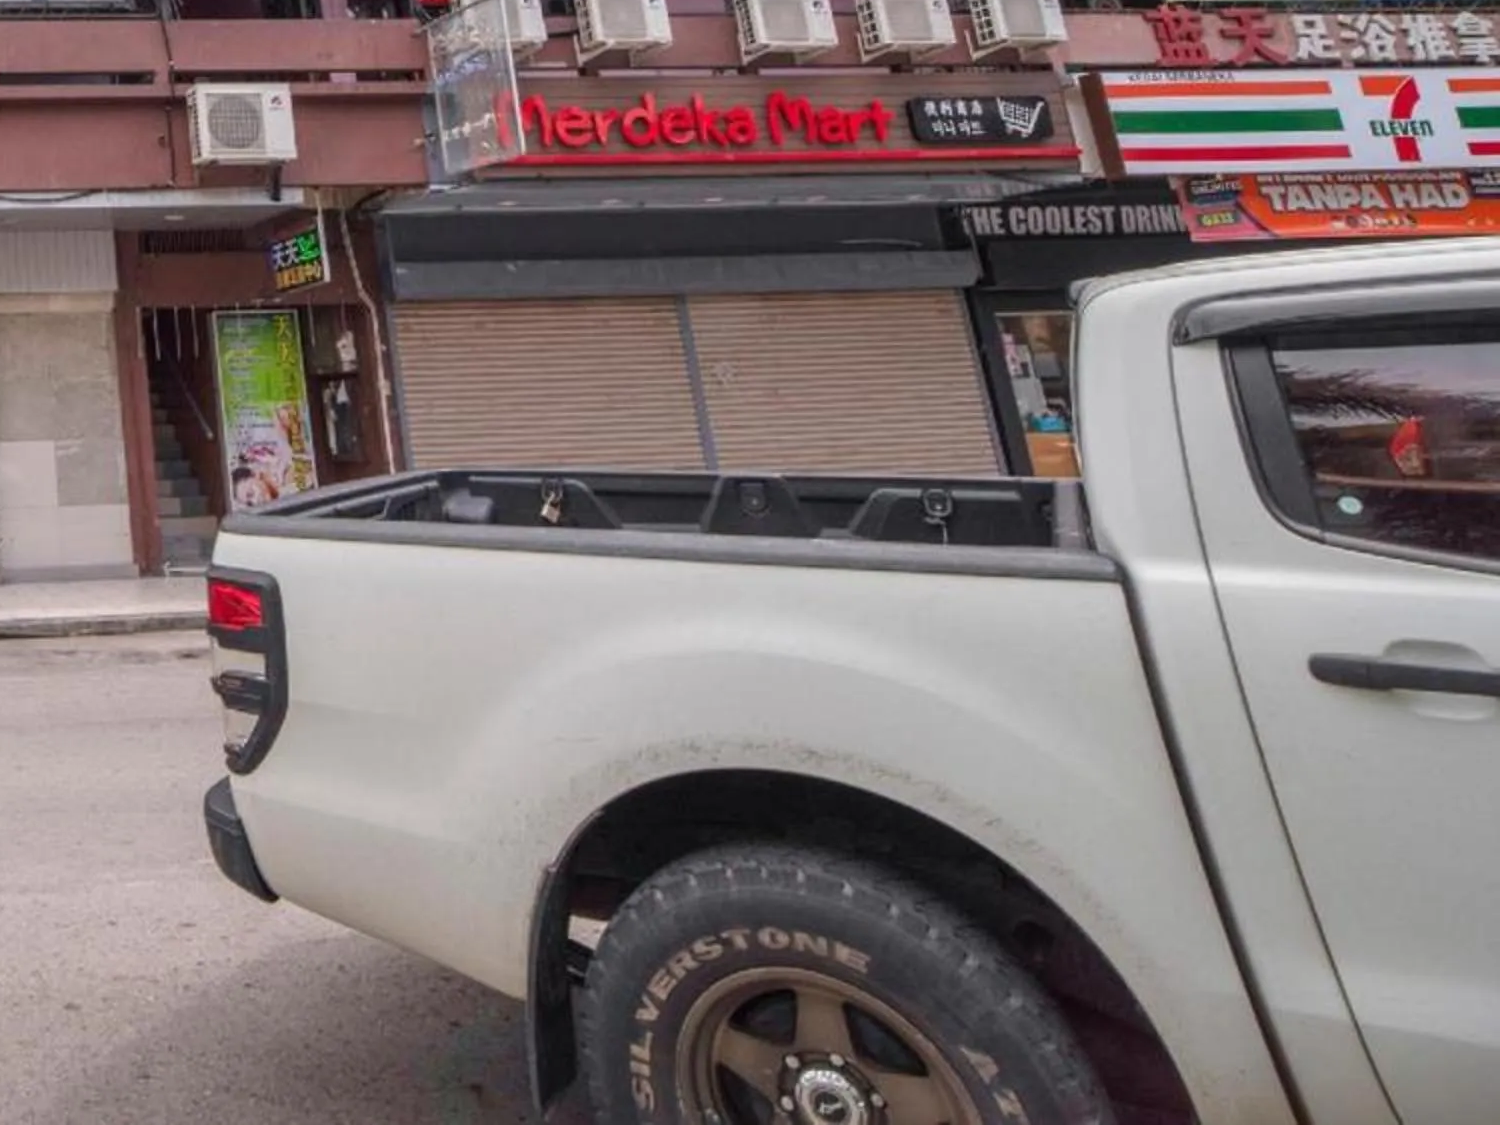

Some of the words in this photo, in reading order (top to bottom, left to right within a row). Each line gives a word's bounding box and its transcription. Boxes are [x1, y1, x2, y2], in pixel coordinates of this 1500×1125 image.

[766, 88, 894, 145] Mart
[1260, 183, 1390, 212] TANPA
[1389, 181, 1471, 210] HAD
[1009, 204, 1115, 235] COOLEST
[629, 926, 872, 1113] SILVERSTONE
